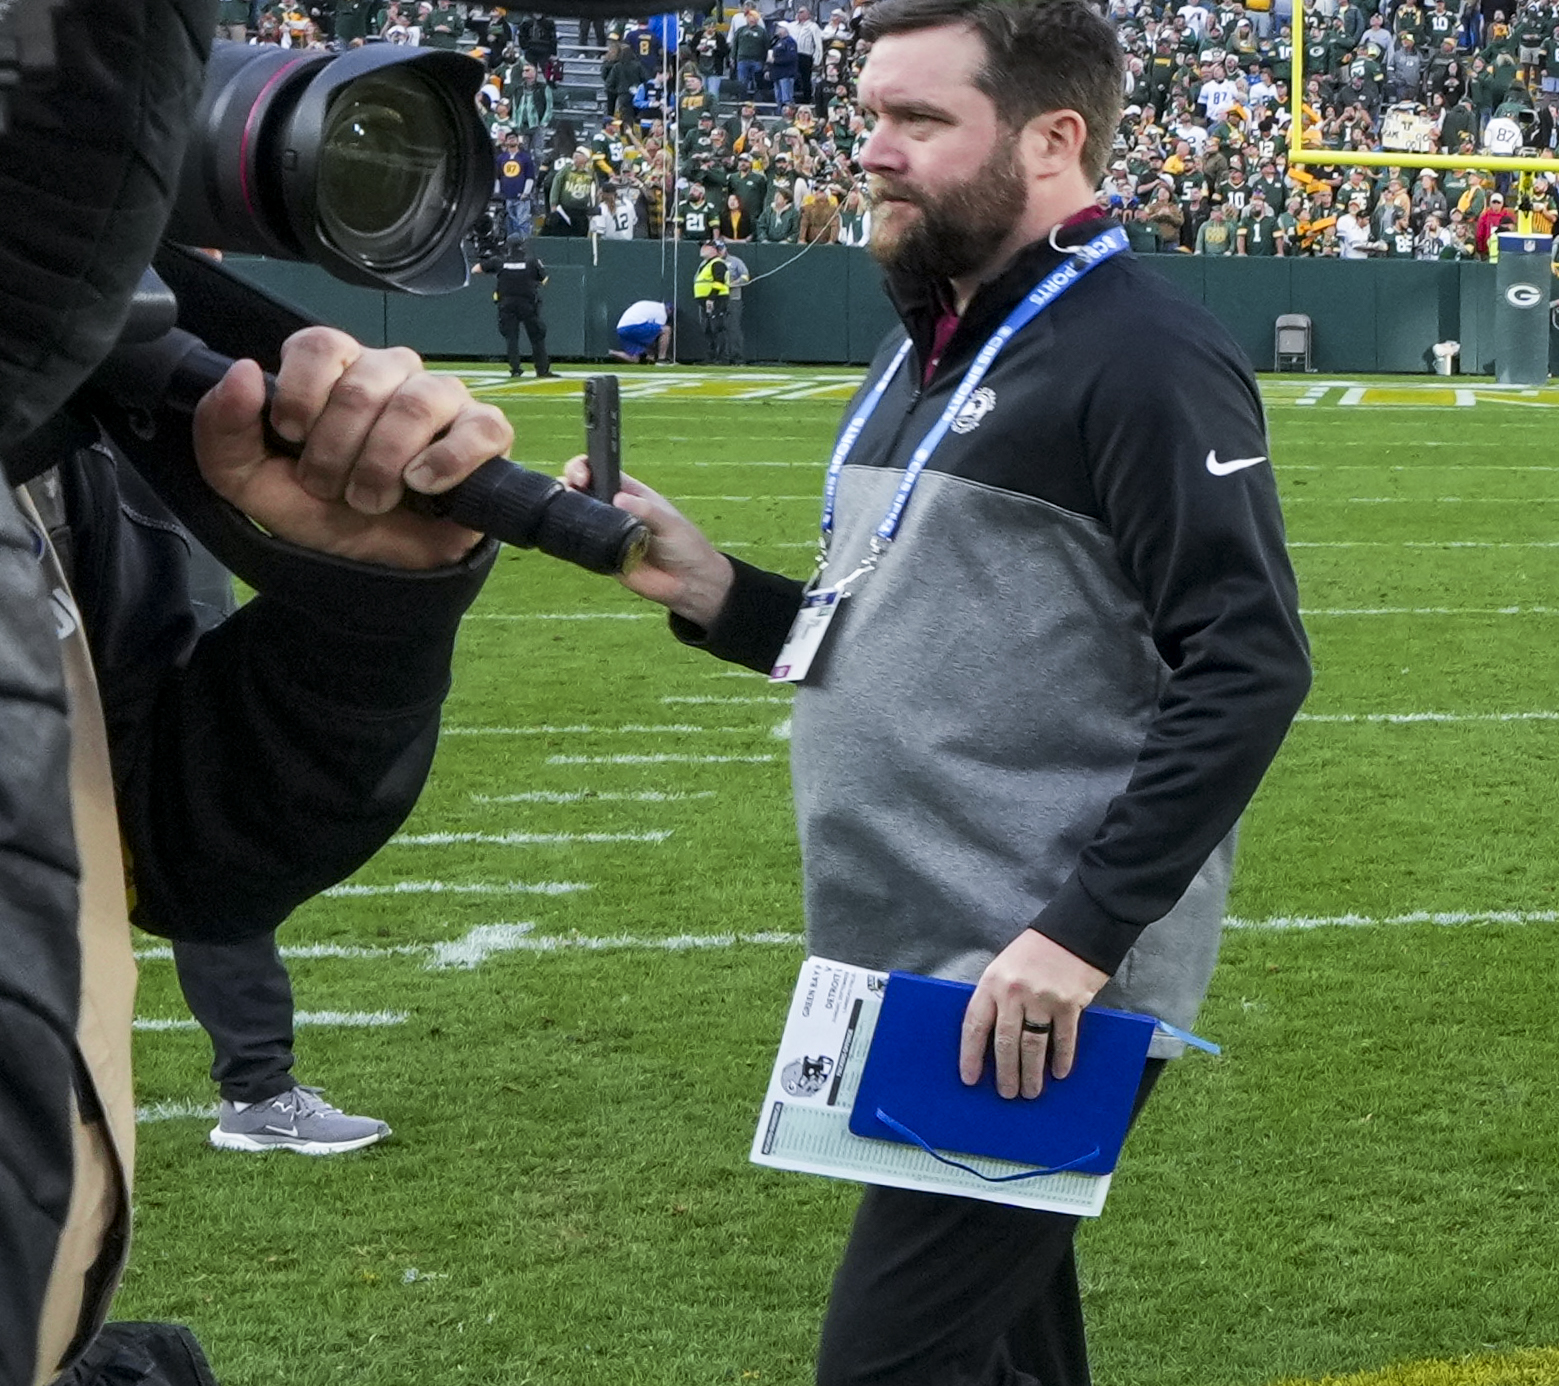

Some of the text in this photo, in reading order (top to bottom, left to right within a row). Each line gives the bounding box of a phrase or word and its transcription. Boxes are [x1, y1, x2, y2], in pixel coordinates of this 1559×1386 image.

[1029, 262, 1078, 306] PORTS
[1505, 283, 1542, 306] G
[942, 336, 1003, 421] CBS SPORTS
[825, 974, 841, 1009] DETROIT
